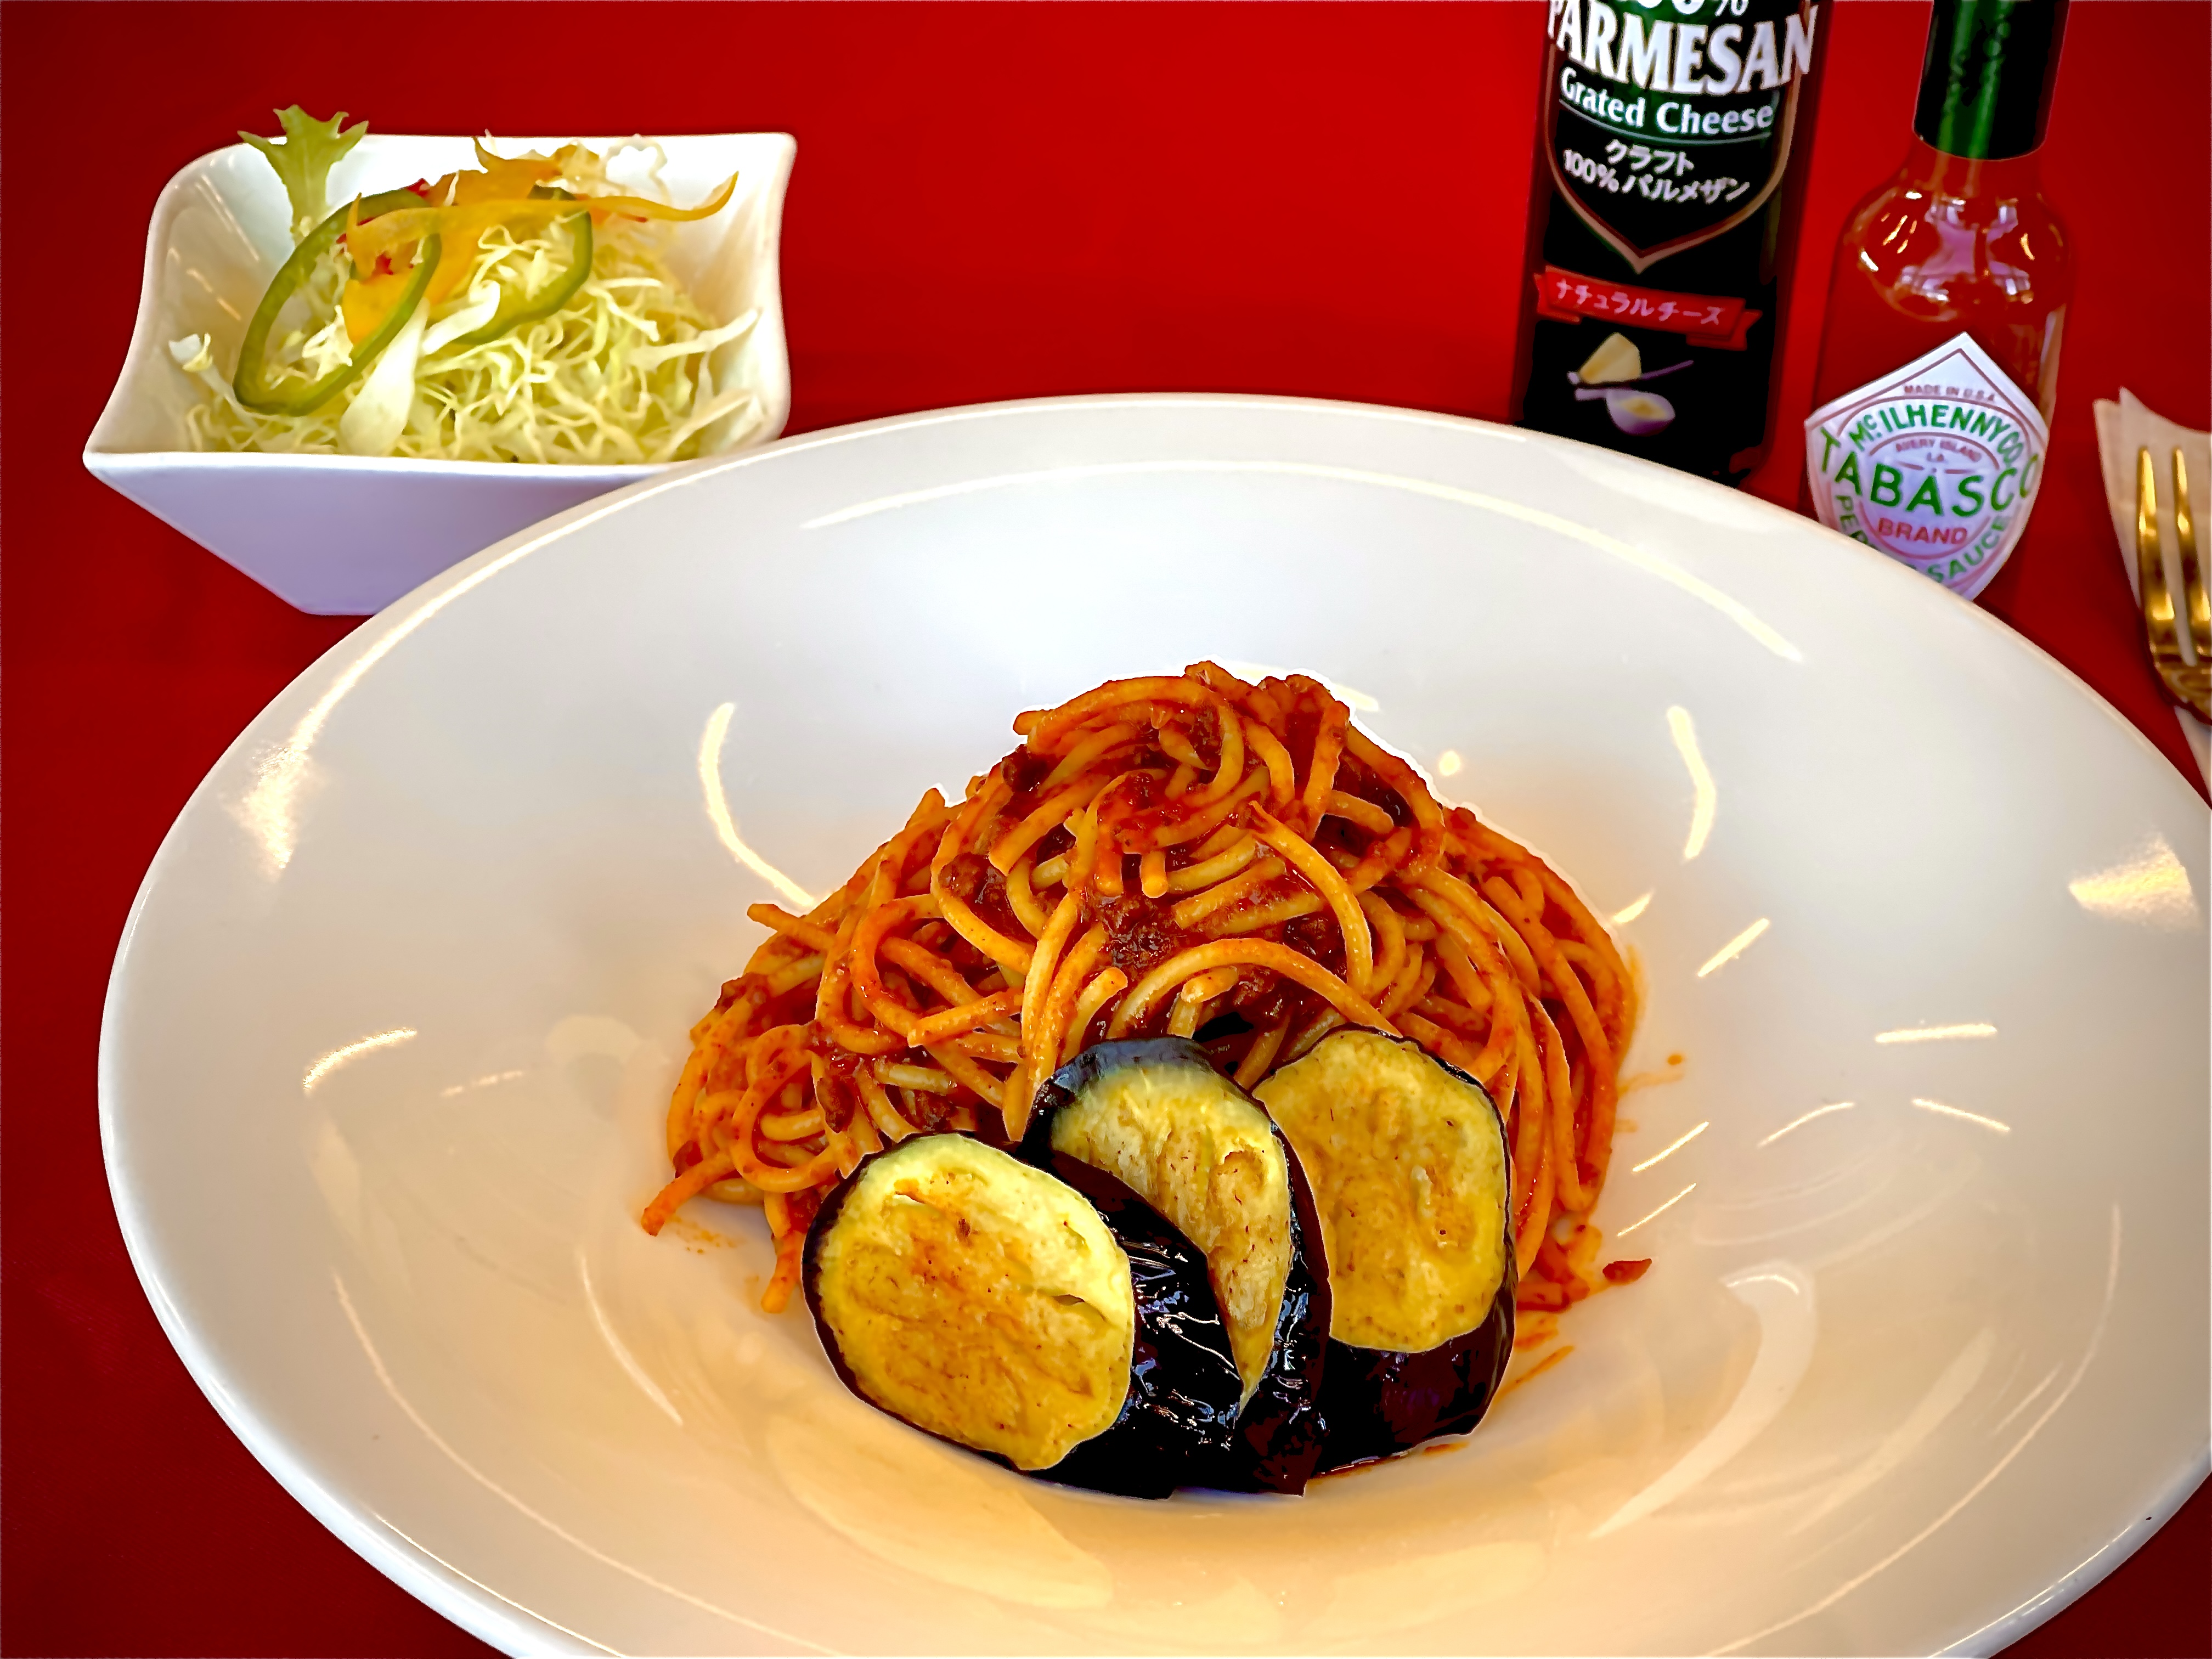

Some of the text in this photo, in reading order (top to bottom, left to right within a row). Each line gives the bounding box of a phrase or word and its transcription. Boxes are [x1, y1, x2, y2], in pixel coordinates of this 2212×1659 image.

[1548, 0, 1818, 95] PARMESAN
[1561, 67, 1774, 136] Grated Cheese
[1605, 139, 1695, 177] クラフト
[1904, 385, 1940, 396] MADE
[1820, 426, 2039, 517] TABASCO
[1878, 517, 1967, 545] BRAND
[1927, 516, 2011, 583] SAUCE
